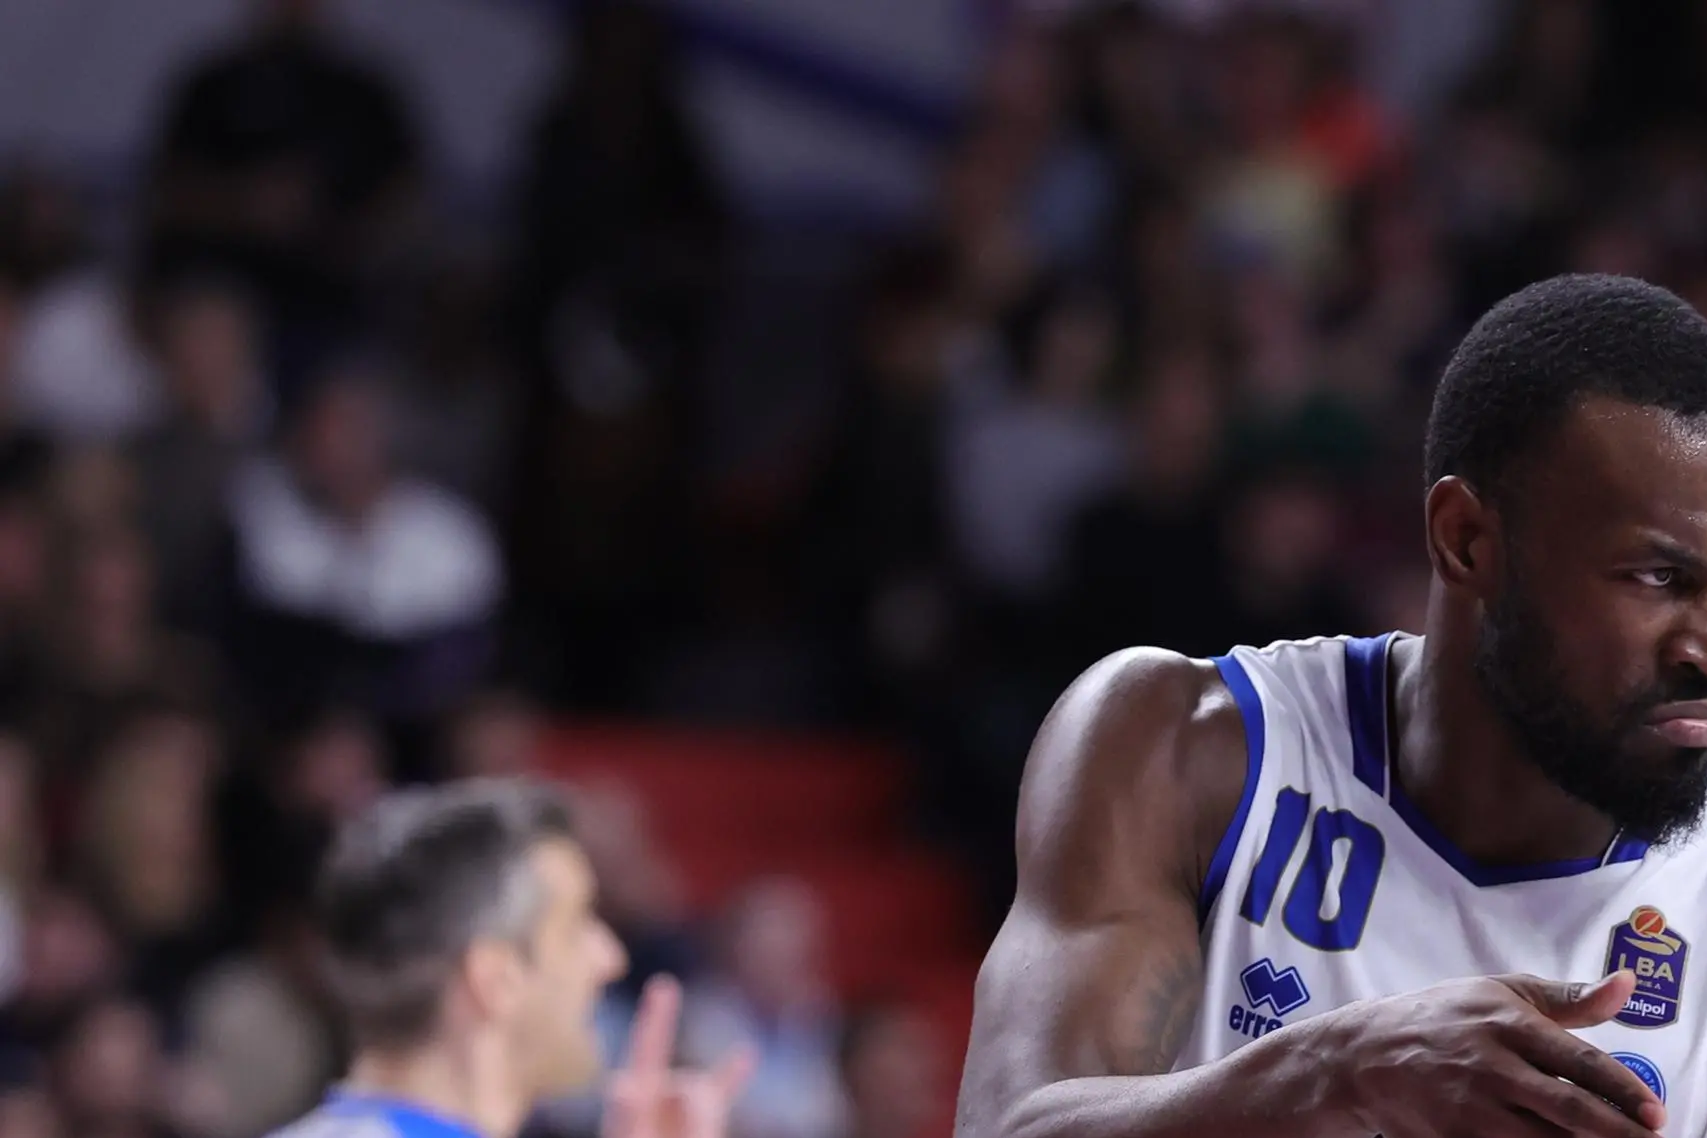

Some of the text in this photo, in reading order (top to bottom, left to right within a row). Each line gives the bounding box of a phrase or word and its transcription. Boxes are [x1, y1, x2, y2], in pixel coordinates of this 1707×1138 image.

[1239, 786, 1386, 953] 10
[1618, 953, 1674, 983] LBA
[1229, 1004, 1283, 1039] erre
